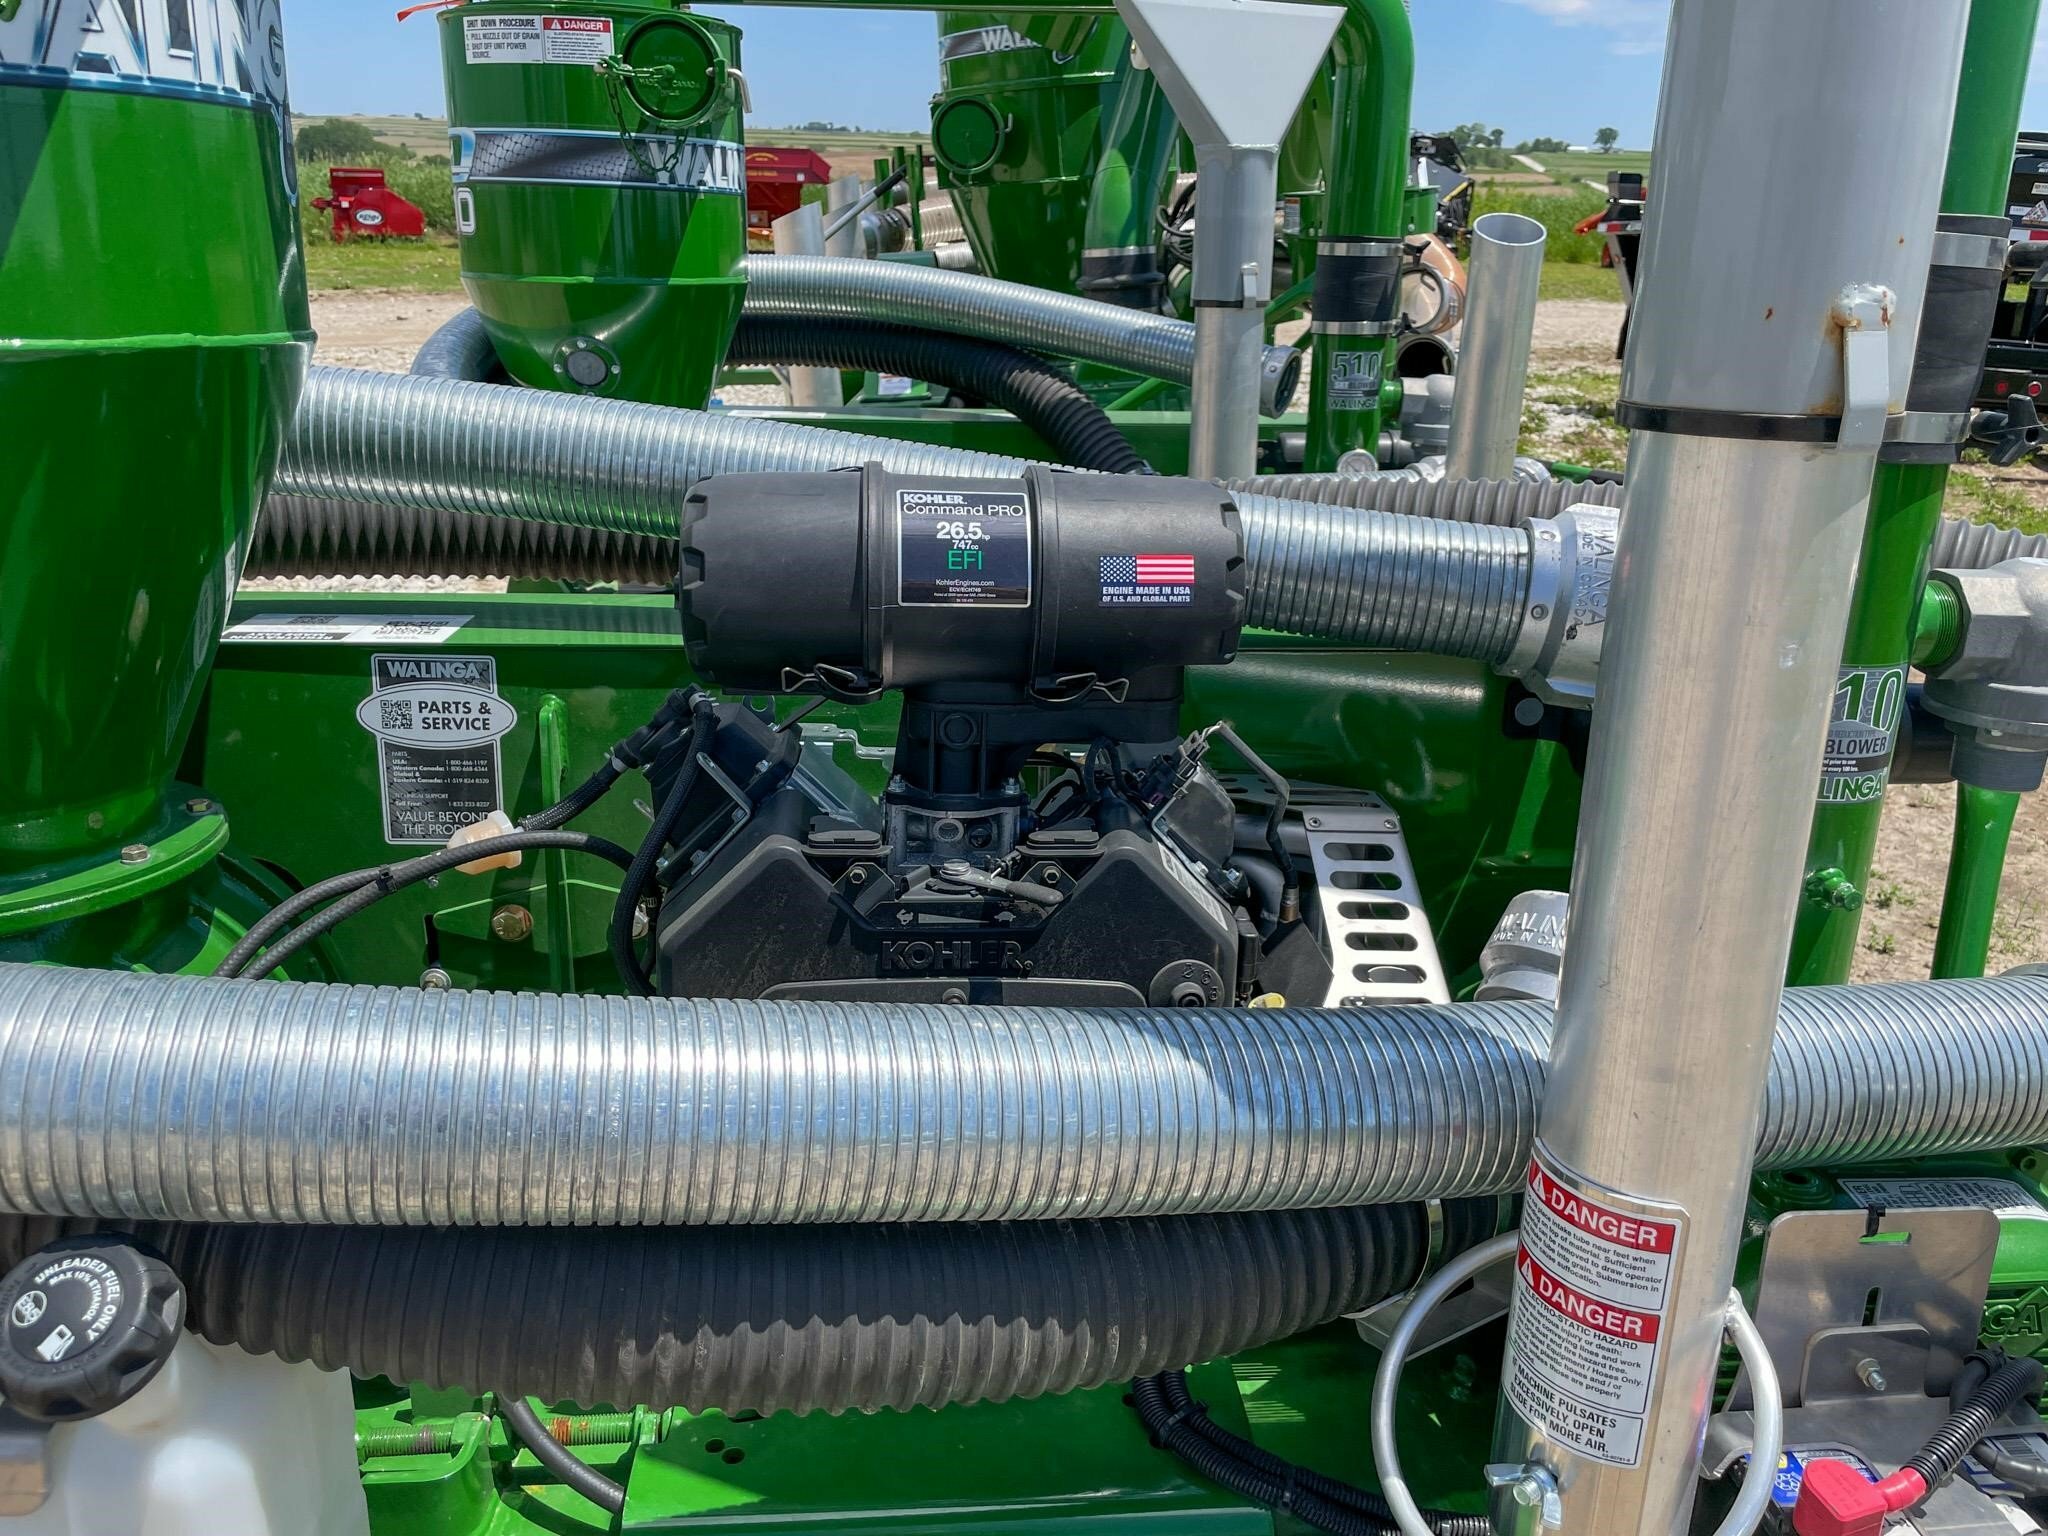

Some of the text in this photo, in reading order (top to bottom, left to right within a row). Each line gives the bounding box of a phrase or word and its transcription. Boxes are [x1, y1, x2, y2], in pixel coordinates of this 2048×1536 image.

[466, 18, 536, 28] SHUT DOWN PROCEDURE
[471, 33, 482, 41] PULL
[563, 20, 604, 31] DANGER
[982, 28, 1042, 51] WAL
[506, 42, 527, 50] POWER
[1331, 352, 1381, 383] 510
[903, 503, 1024, 517] Command PRO
[948, 550, 983, 570] EFI
[1583, 528, 1616, 627] WALINGA
[935, 579, 995, 587] KohlerEngines.com
[1102, 586, 1191, 595] ENGINE MADE IN USA
[1102, 595, 1191, 603] OF U.S. AND GLOBAL PARTS
[1573, 556, 1593, 627] IN CANADA
[386, 661, 480, 679] WALINGA
[418, 701, 492, 715] PARTS &
[421, 717, 491, 731] SERVICE
[1824, 736, 1888, 755] BLOWER
[396, 811, 490, 823] VALUE BEYOND
[402, 823, 425, 835] THE
[1537, 1205, 1655, 1264] place intake tube near feet when
[1551, 1189, 1657, 1246] DANGER
[1539, 1246, 1555, 1263] cause
[1557, 1258, 1601, 1286] suffocation.
[1543, 1238, 1555, 1253] tube
[1557, 1249, 1569, 1262] into
[1571, 1258, 1593, 1275] grain.
[1596, 1270, 1648, 1290] Submersion
[1549, 1225, 1558, 1239] top
[1560, 1233, 1567, 1243] of
[1569, 1239, 1601, 1259] material.
[1604, 1255, 1646, 1272] Sufficient
[1549, 1234, 1556, 1245] be
[1557, 1241, 1588, 1263] removed
[1591, 1258, 1599, 1267] to
[1601, 1262, 1622, 1275] draw
[1624, 1270, 1661, 1285] operator
[34, 1257, 121, 1341] UNLEADED FUEL ONLY
[49, 1271, 74, 1286] MAX
[81, 1279, 103, 1322] ETHANOL
[1525, 1285, 1590, 1336] ELECTRO-STATIC
[1593, 1331, 1637, 1349] HAZARD
[1539, 1276, 1643, 1335] DANGER
[1529, 1310, 1540, 1323] sure
[1542, 1319, 1577, 1349] conveying
[1580, 1343, 1598, 1356] lines
[1601, 1352, 1618, 1363] and
[1620, 1358, 1641, 1368] work
[1535, 1323, 1548, 1339] dust
[1550, 1335, 1562, 1348] and
[1564, 1344, 1575, 1355] fire
[1578, 1351, 1606, 1368] hazard
[1609, 1363, 1627, 1374] free.
[1537, 1306, 1622, 1355] serious injury or death:
[1524, 1321, 1544, 1347] Original
[1546, 1341, 1585, 1370] Equipment
[1592, 1366, 1618, 1380] Hoses
[1621, 1375, 1643, 1387] Only.
[1529, 1337, 1538, 1349] use
[1540, 1345, 1561, 1368] plastic
[1564, 1363, 1587, 1379] hoses
[1589, 1374, 1605, 1385] and
[1518, 1361, 1555, 1403] MACHINE
[1558, 1396, 1616, 1428] PULSATES
[1549, 1362, 1569, 1379] those
[1571, 1376, 1583, 1386] are
[1585, 1382, 1621, 1399] properly
[1510, 1380, 1608, 1452] SLIDE FOR MORE AIR.
[1514, 1372, 1604, 1438] EXCESSIVELY, OPEN
